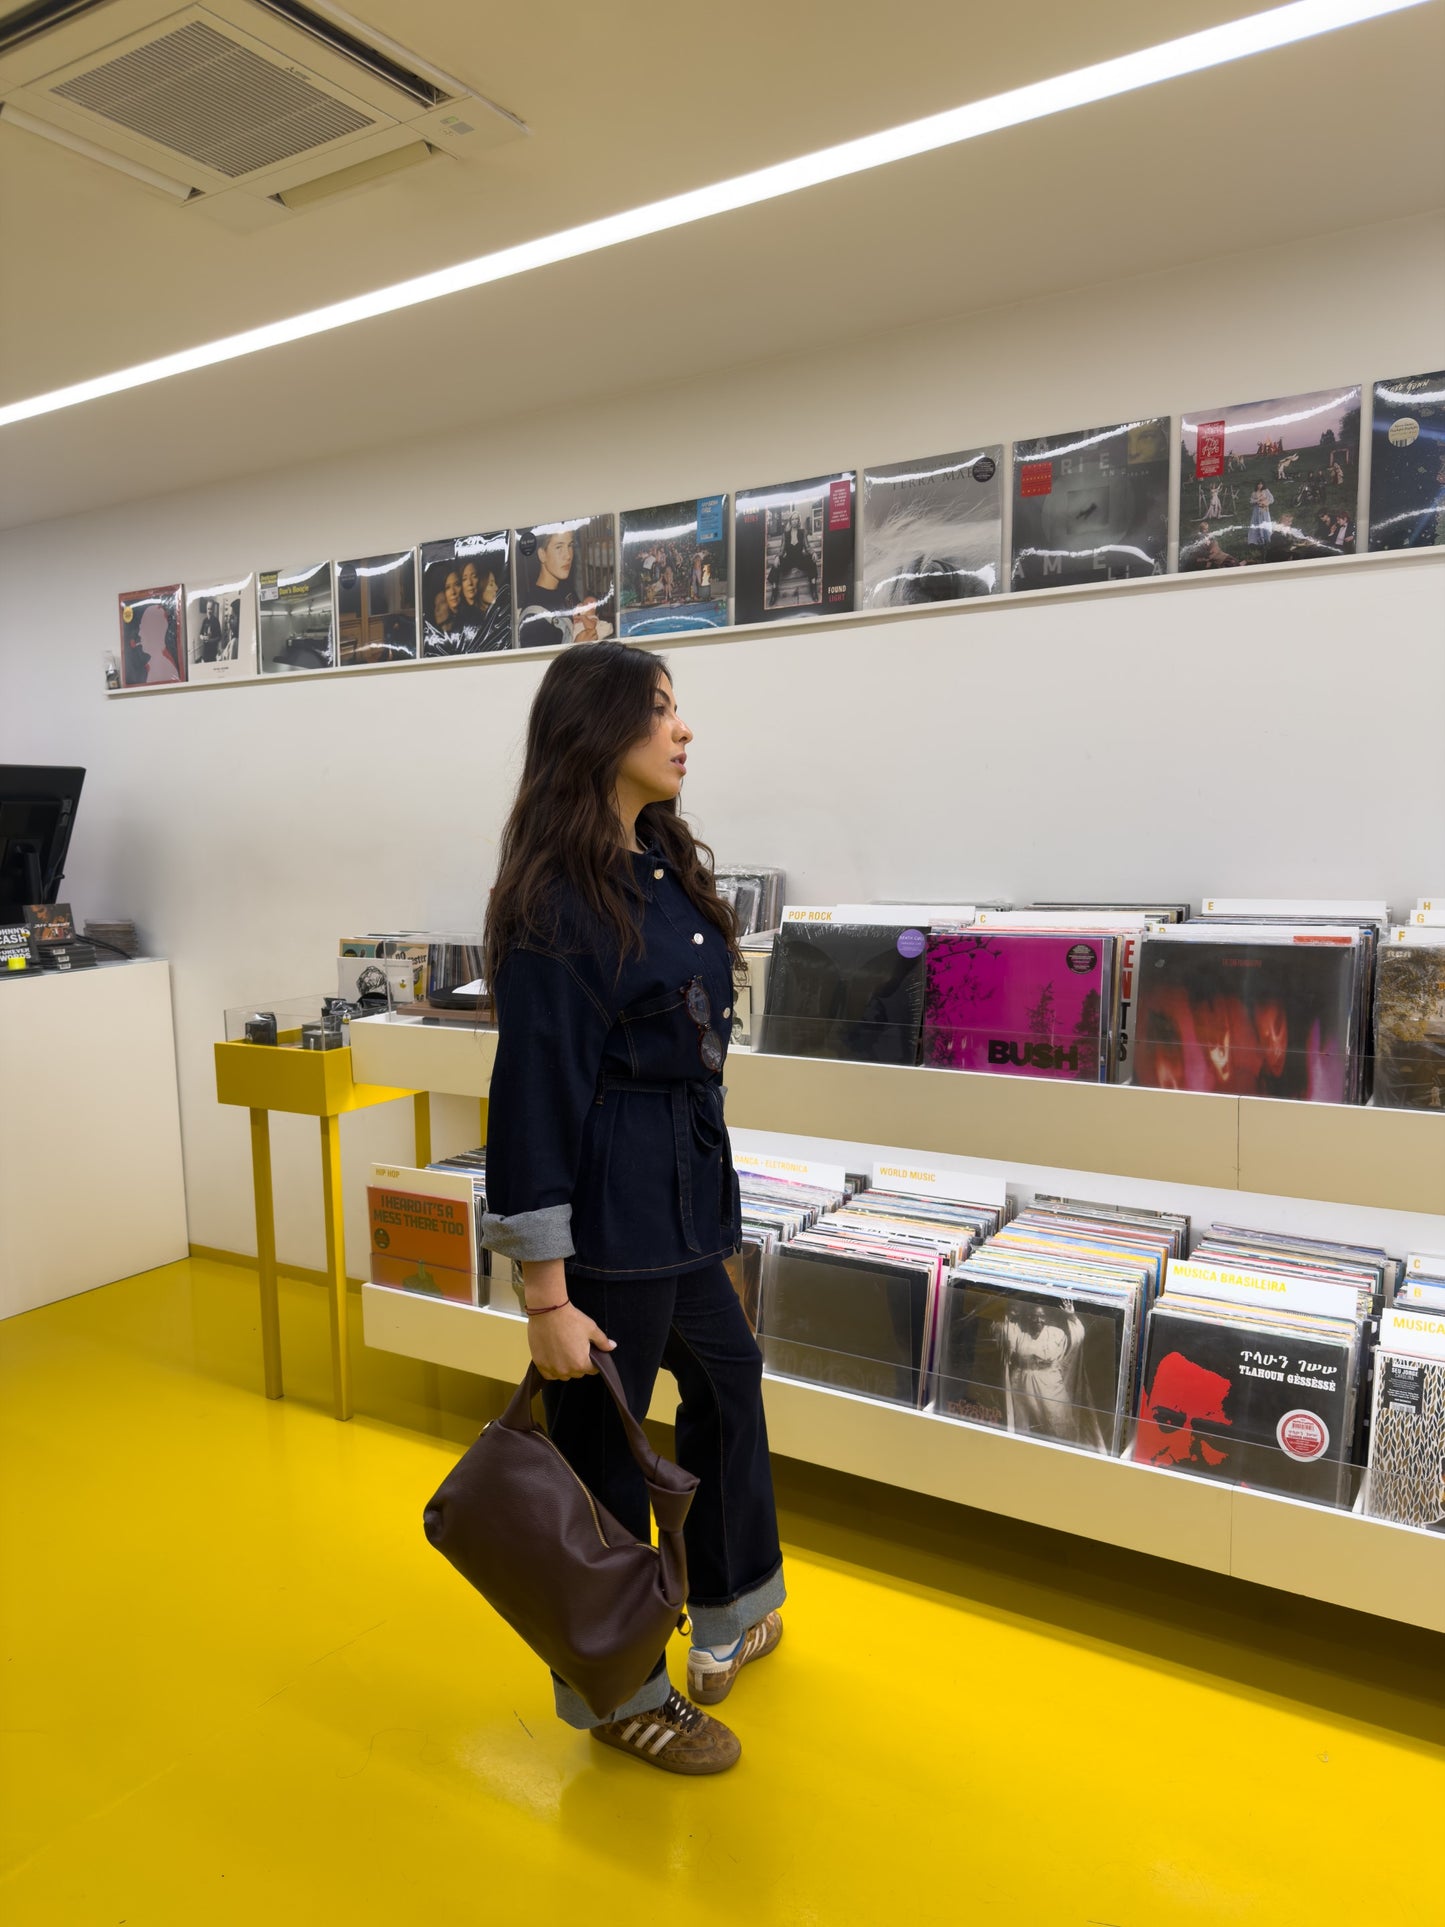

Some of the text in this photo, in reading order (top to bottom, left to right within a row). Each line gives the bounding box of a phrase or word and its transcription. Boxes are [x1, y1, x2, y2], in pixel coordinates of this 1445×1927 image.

[827, 584, 847, 595] FOUND
[1207, 901, 1214, 911] E
[1423, 901, 1431, 911] H
[788, 911, 832, 921] POP ROCK
[979, 914, 986, 924] C
[1416, 913, 1425, 924] G
[1398, 930, 1406, 942] F
[988, 1039, 1079, 1071] BUSH
[375, 1168, 400, 1179] HIP HOP
[879, 1167, 936, 1182] WORLD MUSIC
[381, 1195, 454, 1219] I HEARD IT'S A
[373, 1209, 465, 1236] MESS THERE TOO
[1413, 1258, 1421, 1269] C
[1220, 1271, 1287, 1293] BRASILEIRA
[1413, 1287, 1422, 1298] B
[1239, 1364, 1285, 1382] TLAHOUN
